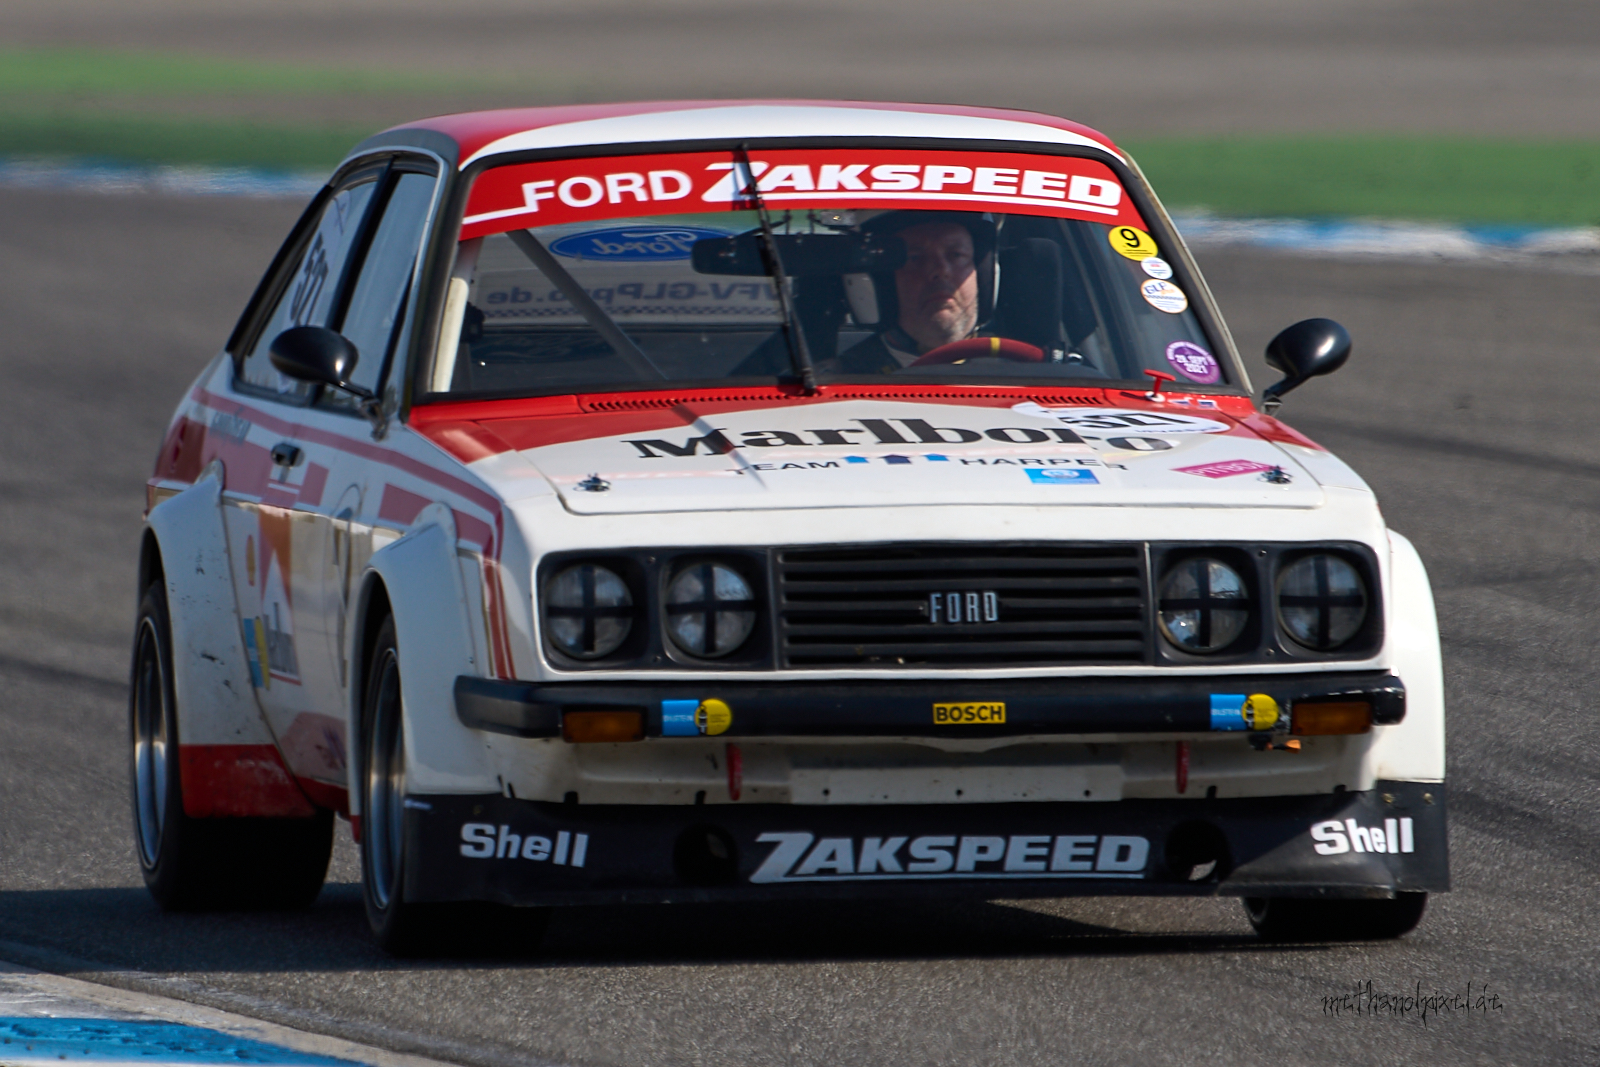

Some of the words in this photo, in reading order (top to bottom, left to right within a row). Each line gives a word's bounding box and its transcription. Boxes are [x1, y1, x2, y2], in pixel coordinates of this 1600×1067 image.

[521, 169, 693, 213] FORD
[701, 161, 1122, 216] ZAKSPEED
[1119, 228, 1141, 249] 9
[620, 417, 1176, 459] Marlboro
[725, 460, 841, 475] TEAM
[957, 457, 1129, 471] HARPER
[929, 592, 999, 624] FORD
[935, 704, 1004, 723] BOSCH
[460, 822, 589, 868] Shell
[1310, 816, 1415, 856] Shell
[749, 832, 1151, 884] ZAKSPEED
